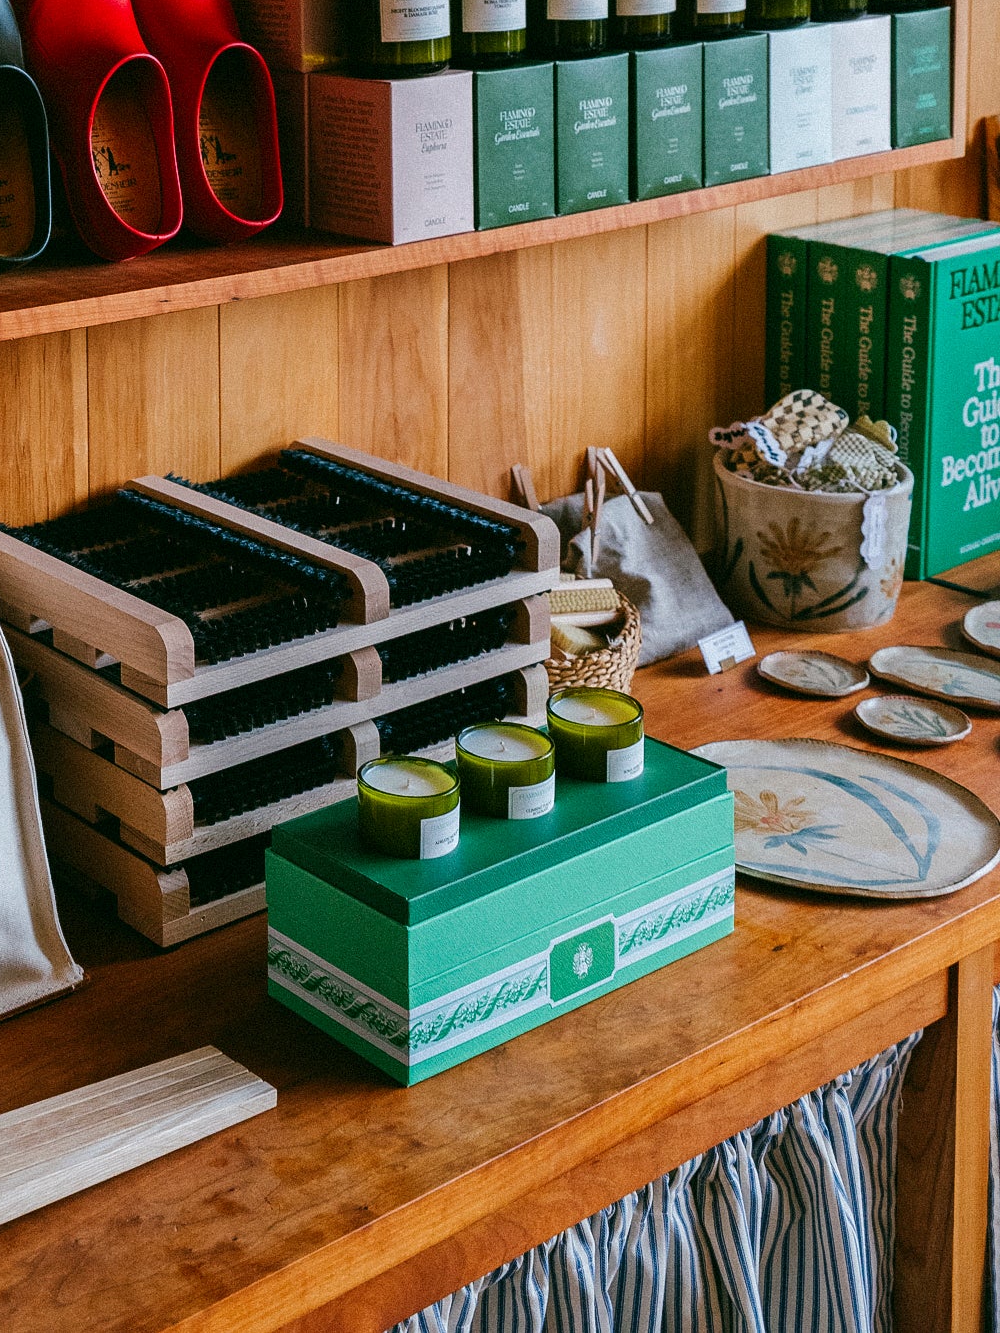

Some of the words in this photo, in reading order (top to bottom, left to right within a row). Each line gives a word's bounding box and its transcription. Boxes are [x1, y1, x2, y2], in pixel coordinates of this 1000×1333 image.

[579, 96, 613, 111] FLAMINGO
[655, 84, 688, 99] FLAMINGO
[415, 118, 453, 133] FLAMINGO
[499, 107, 536, 122] FLAMINGO
[504, 117, 531, 131] ESTATE
[583, 107, 609, 120] ESTATE
[420, 129, 448, 143] ESTATE
[508, 201, 530, 213] CANDLE
[586, 188, 608, 200] CANDLE
[424, 217, 446, 227] CANDLE
[949, 260, 1000, 300] FLAM
[780, 291, 794, 319] The
[821, 298, 834, 326] The
[961, 295, 1000, 331] EST
[860, 305, 873, 334] The
[903, 315, 917, 344] The
[780, 320, 794, 364] Guide
[820, 328, 834, 371] Guide
[780, 364, 792, 380] to
[858, 336, 873, 381] Guide
[901, 346, 916, 392] Guide
[820, 373, 832, 388] to
[974, 357, 1000, 392] Th
[857, 383, 869, 398] to
[901, 394, 913, 408] to
[962, 390, 1000, 427] Gui
[899, 411, 914, 464] Becom
[981, 423, 1000, 449] to
[940, 447, 1000, 487] Becom
[962, 474, 1000, 512] Aliv
